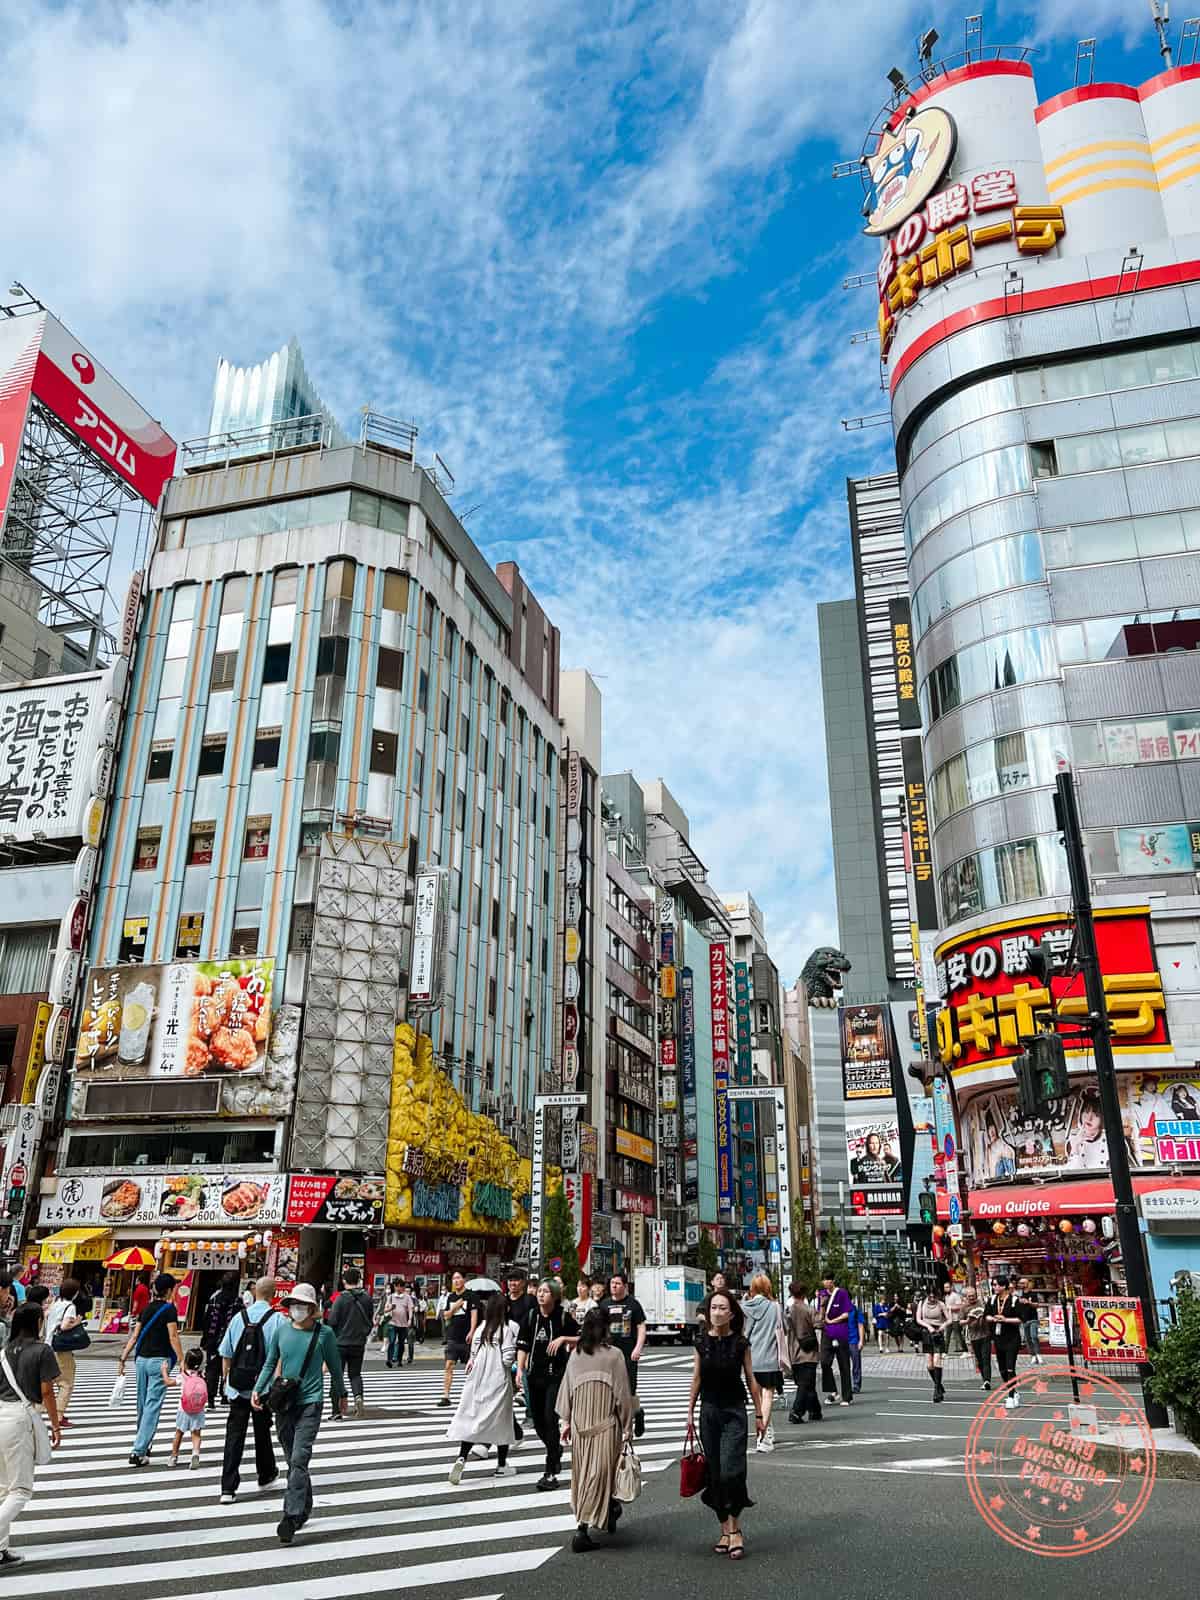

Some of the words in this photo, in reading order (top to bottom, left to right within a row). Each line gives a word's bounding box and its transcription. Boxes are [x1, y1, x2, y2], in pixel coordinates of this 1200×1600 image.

[74, 398, 136, 476] アコム
[48, 692, 88, 819] おやじが喜ぶ
[1140, 736, 1170, 760] 新宿
[26, 710, 62, 819] こだわりの
[712, 948, 726, 1052] カラオケ歌広場
[88, 978, 105, 1072] レモンサワー
[532, 1119, 543, 1197] GODZILLA
[777, 1124, 788, 1233] ゴジラロード
[62, 1179, 83, 1205] 虎
[290, 1200, 319, 1208] 焼きそば
[867, 1192, 901, 1203] MARUHAN
[46, 1206, 86, 1220] とらそば
[136, 1210, 154, 1221] 580
[198, 1210, 215, 1221] 600
[258, 1210, 277, 1220] 590
[979, 1203, 1001, 1214] Don
[1006, 1200, 1050, 1214] Quijote
[531, 1206, 541, 1244] ROAD
